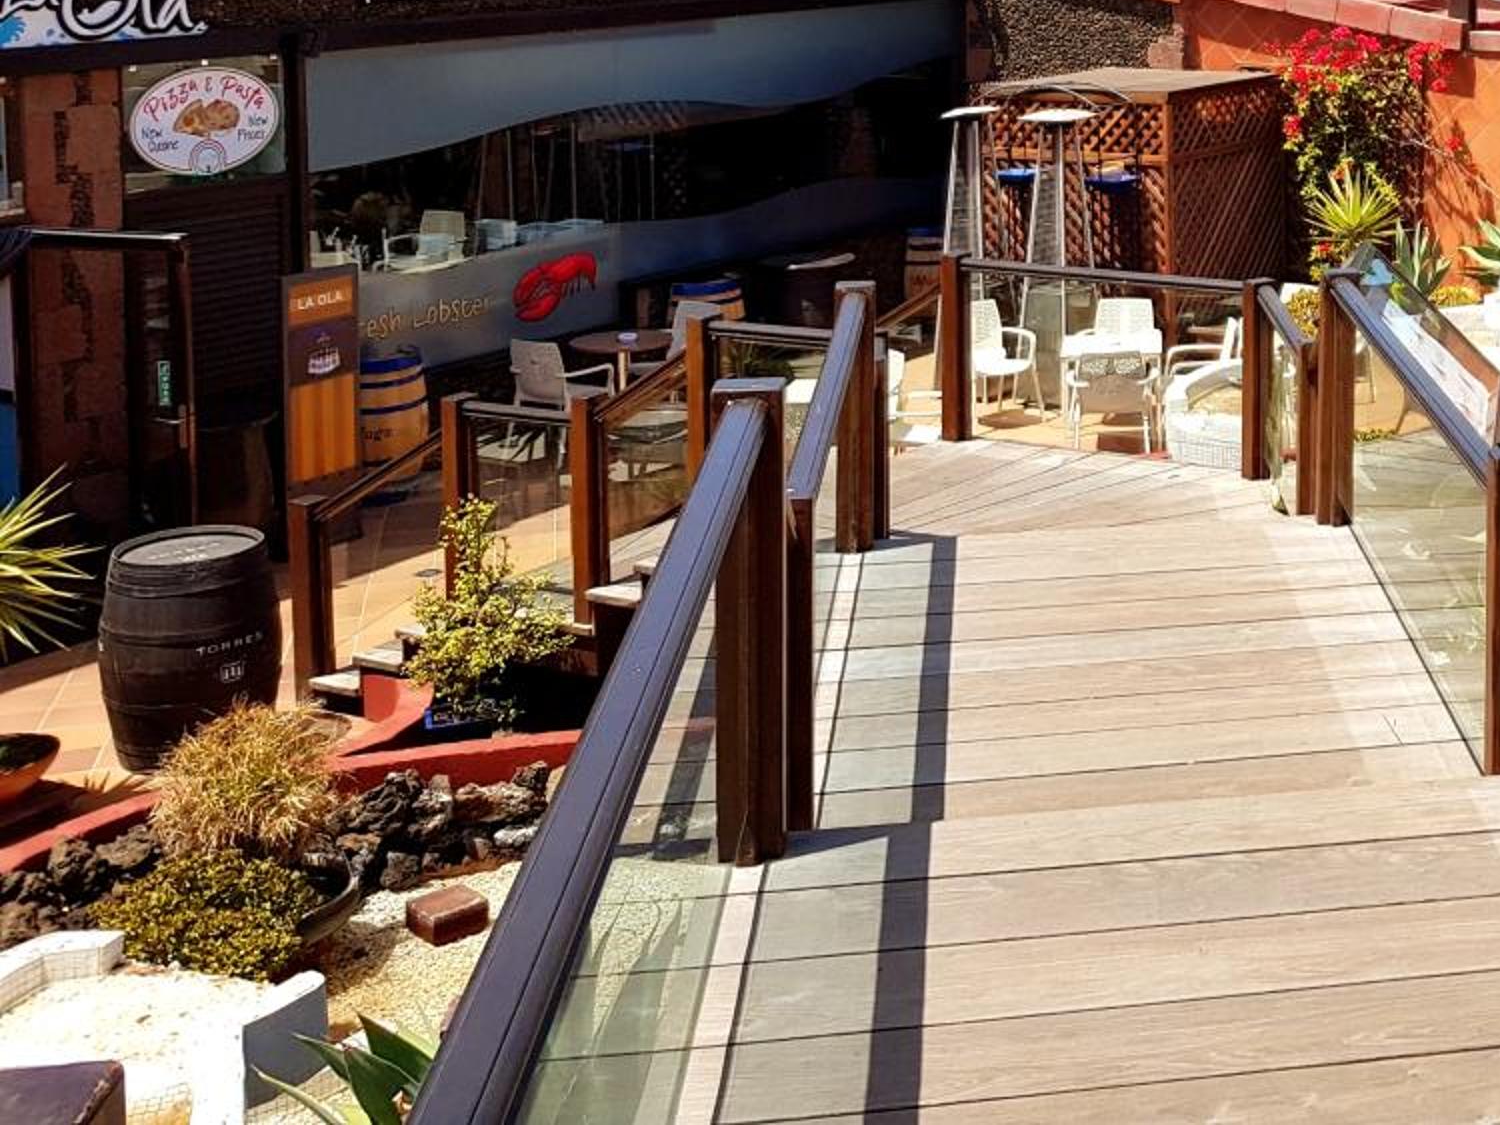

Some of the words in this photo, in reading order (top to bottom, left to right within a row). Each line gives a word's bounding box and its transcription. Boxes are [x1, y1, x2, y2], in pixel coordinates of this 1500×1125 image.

[143, 79, 198, 122] Pizza
[220, 75, 265, 110] Pasta
[141, 127, 163, 140] New
[297, 294, 314, 310] LA
[317, 290, 344, 306] OLA
